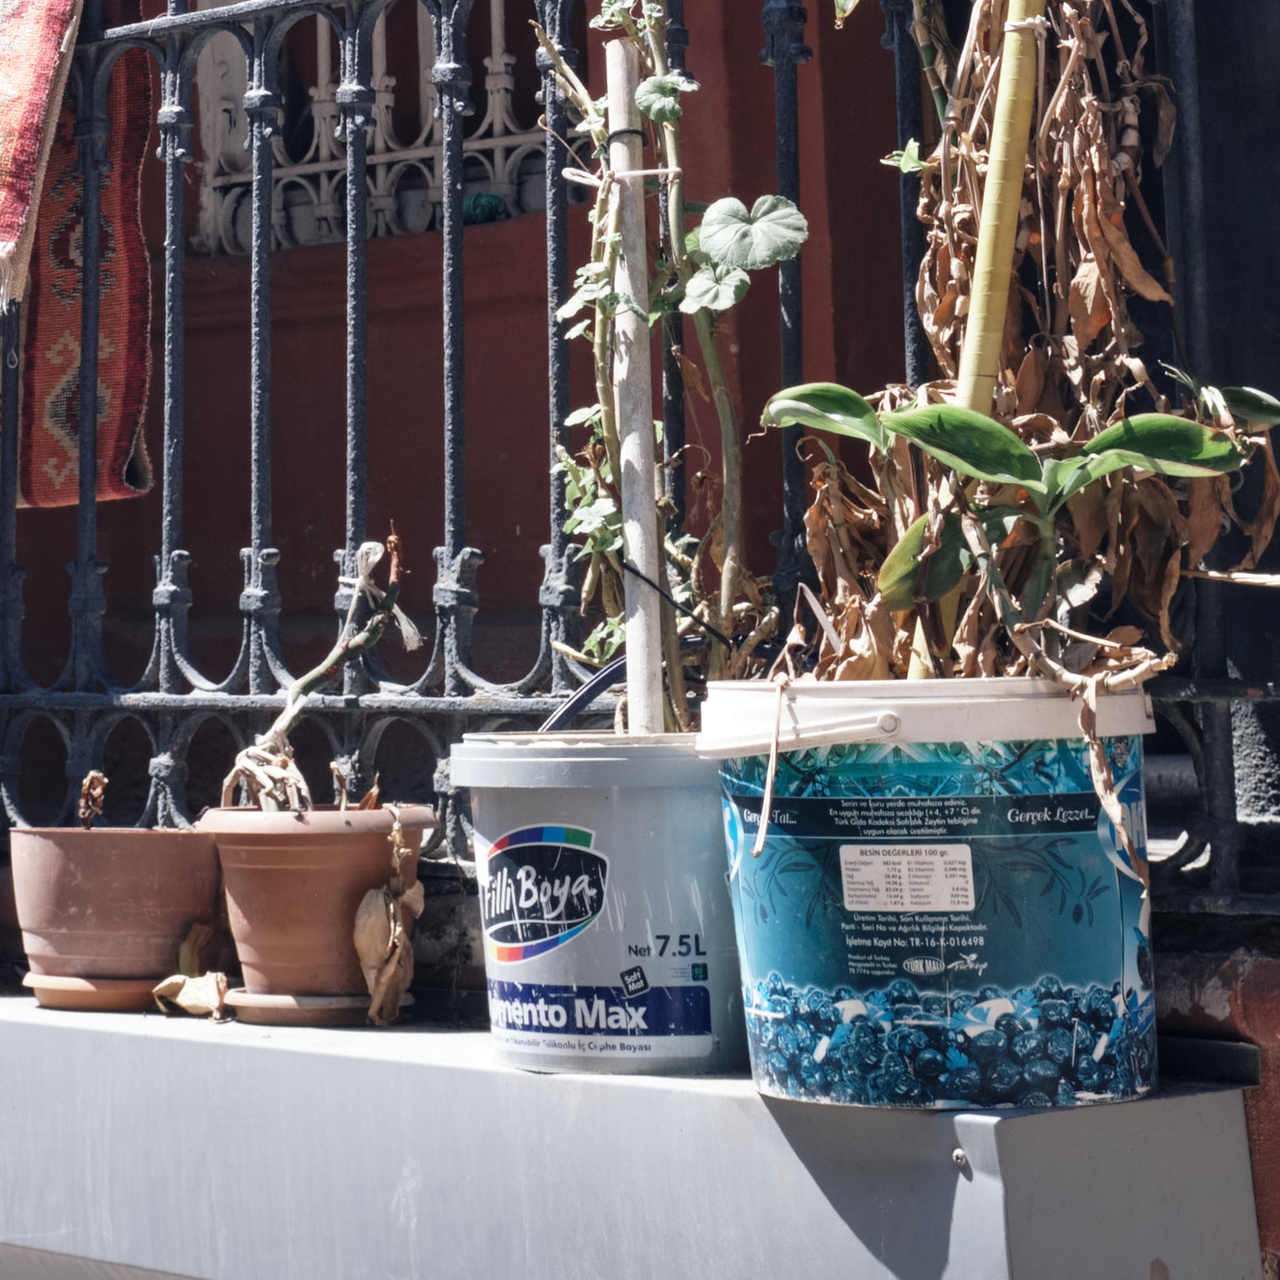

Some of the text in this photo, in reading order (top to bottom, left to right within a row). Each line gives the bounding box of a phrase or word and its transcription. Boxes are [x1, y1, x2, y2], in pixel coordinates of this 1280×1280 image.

[886, 800, 906, 808] yerde
[907, 799, 943, 807] muhafaza
[829, 808, 838, 816] En
[970, 806, 982, 815] dir.
[1007, 807, 1052, 825] Gerçek
[834, 817, 849, 825] Türk
[868, 817, 895, 825] Kodeksi
[924, 817, 945, 826] Zeytin
[859, 848, 880, 856] BESİN
[881, 848, 922, 856] DEĞERLERİ
[516, 865, 597, 919] Boya
[853, 912, 876, 921] Üretim
[877, 914, 898, 923] Tarihi,
[914, 914, 948, 922] Kullanma
[949, 914, 971, 922] Tarihi,
[841, 922, 856, 930] Parti
[861, 923, 875, 931] Seri
[628, 934, 707, 957] Net 7.5L
[846, 933, 985, 949] İşletme Kayıt No: TR-16-K-016498
[624, 971, 642, 984] Soft
[628, 979, 644, 992] Mat
[575, 998, 648, 1030] Max
[619, 1042, 651, 1053] Boyası
